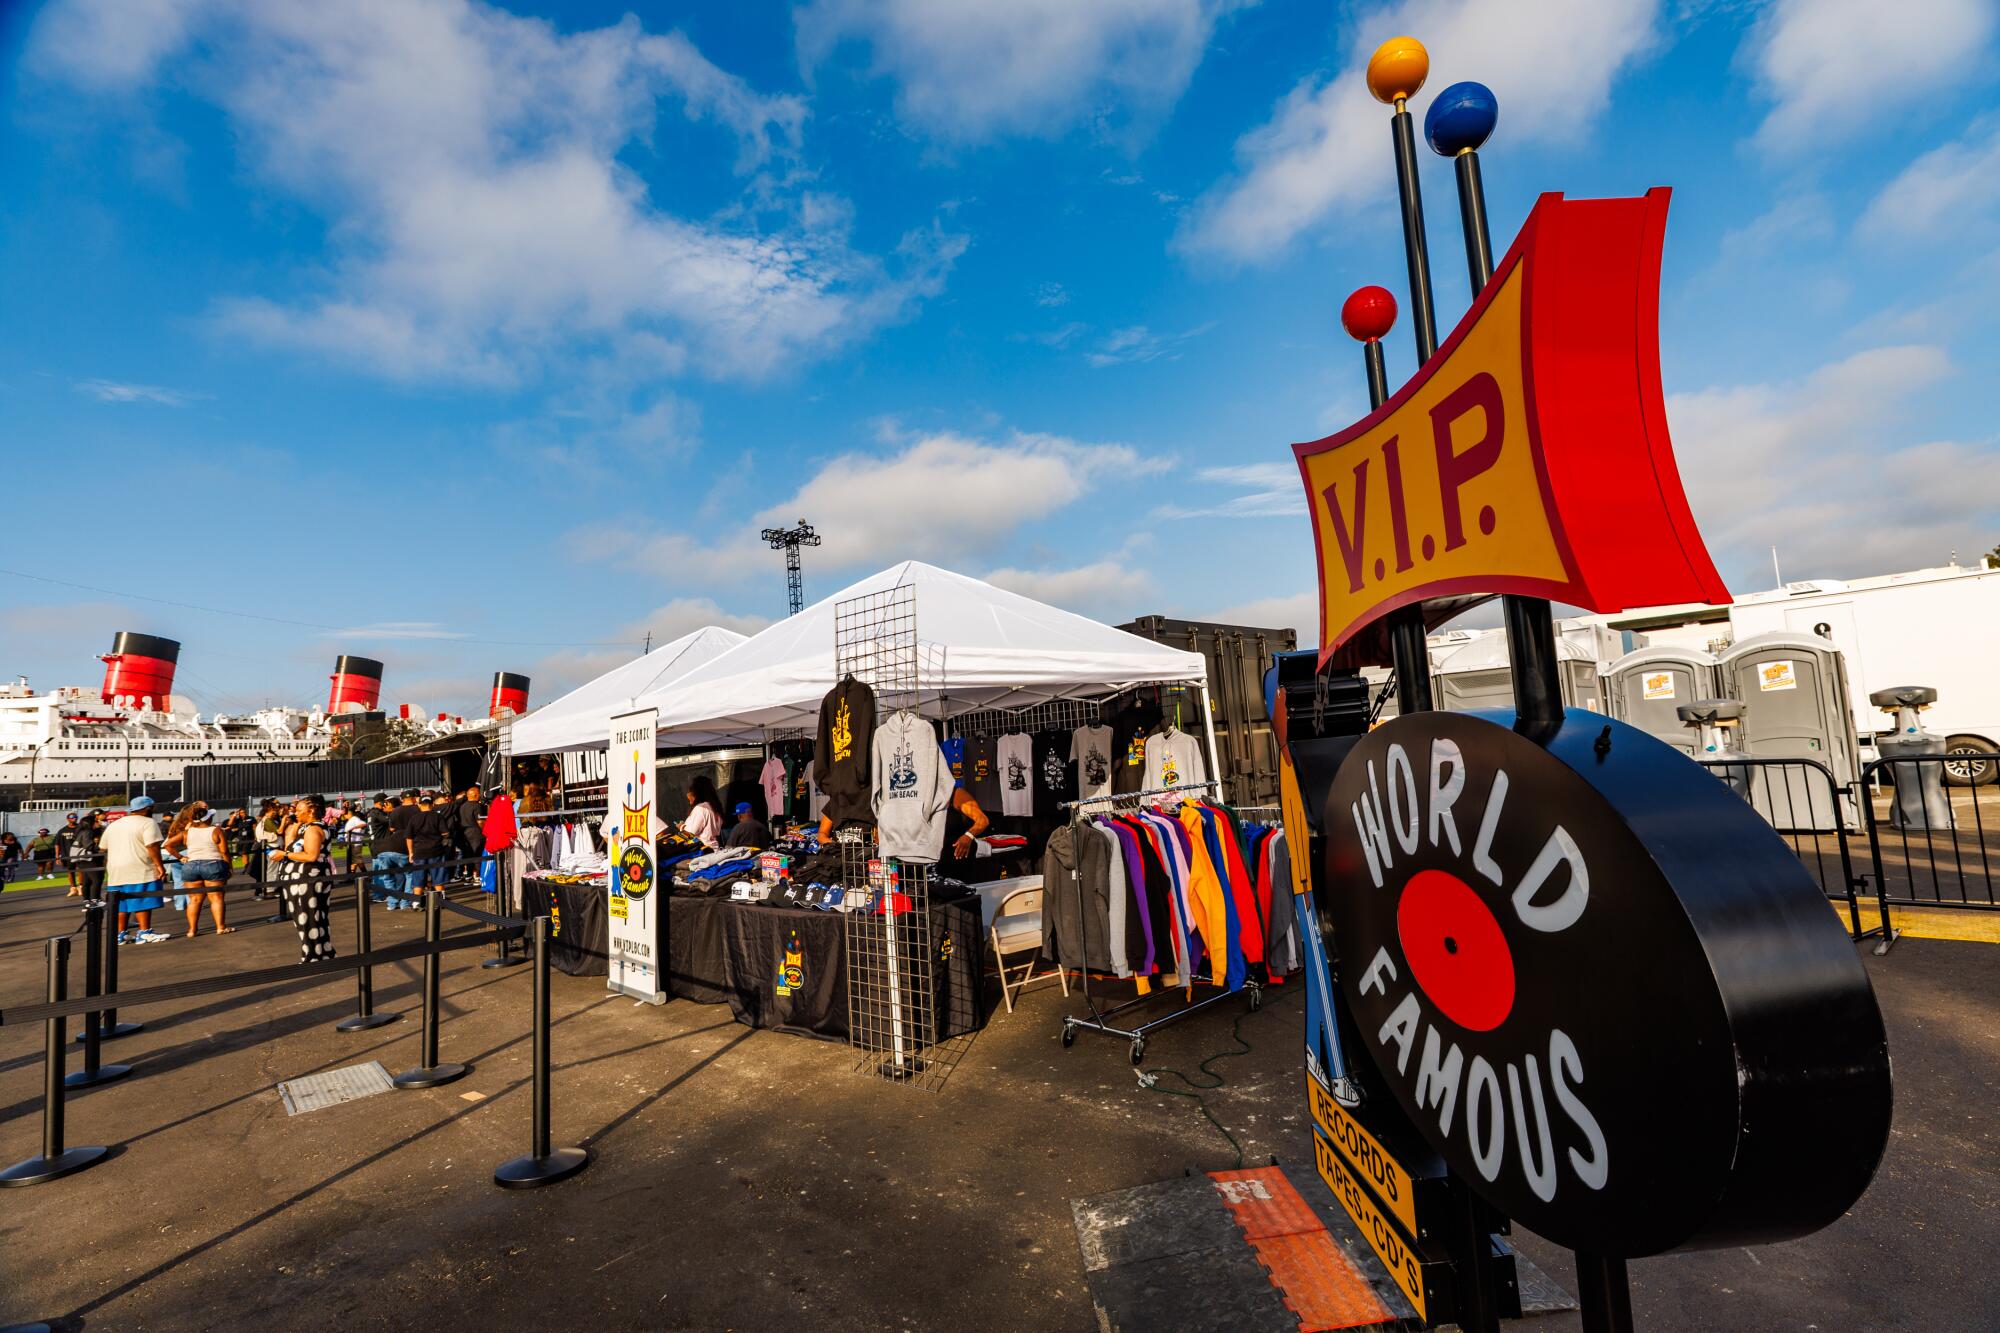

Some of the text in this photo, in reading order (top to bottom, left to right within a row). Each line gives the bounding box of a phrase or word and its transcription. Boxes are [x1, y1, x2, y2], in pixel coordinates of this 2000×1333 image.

[1322, 371, 1505, 594] V.I.P.
[616, 727, 650, 744] THE ICONIC
[568, 795, 587, 803] OFFICIAL
[899, 790, 918, 798] BEACH
[1352, 738, 1589, 932] WORLD
[624, 849, 646, 867] World
[621, 873, 649, 892] Famous
[1359, 946, 1608, 1203] FAMOUS
[1317, 1088, 1398, 1202] RECORDS
